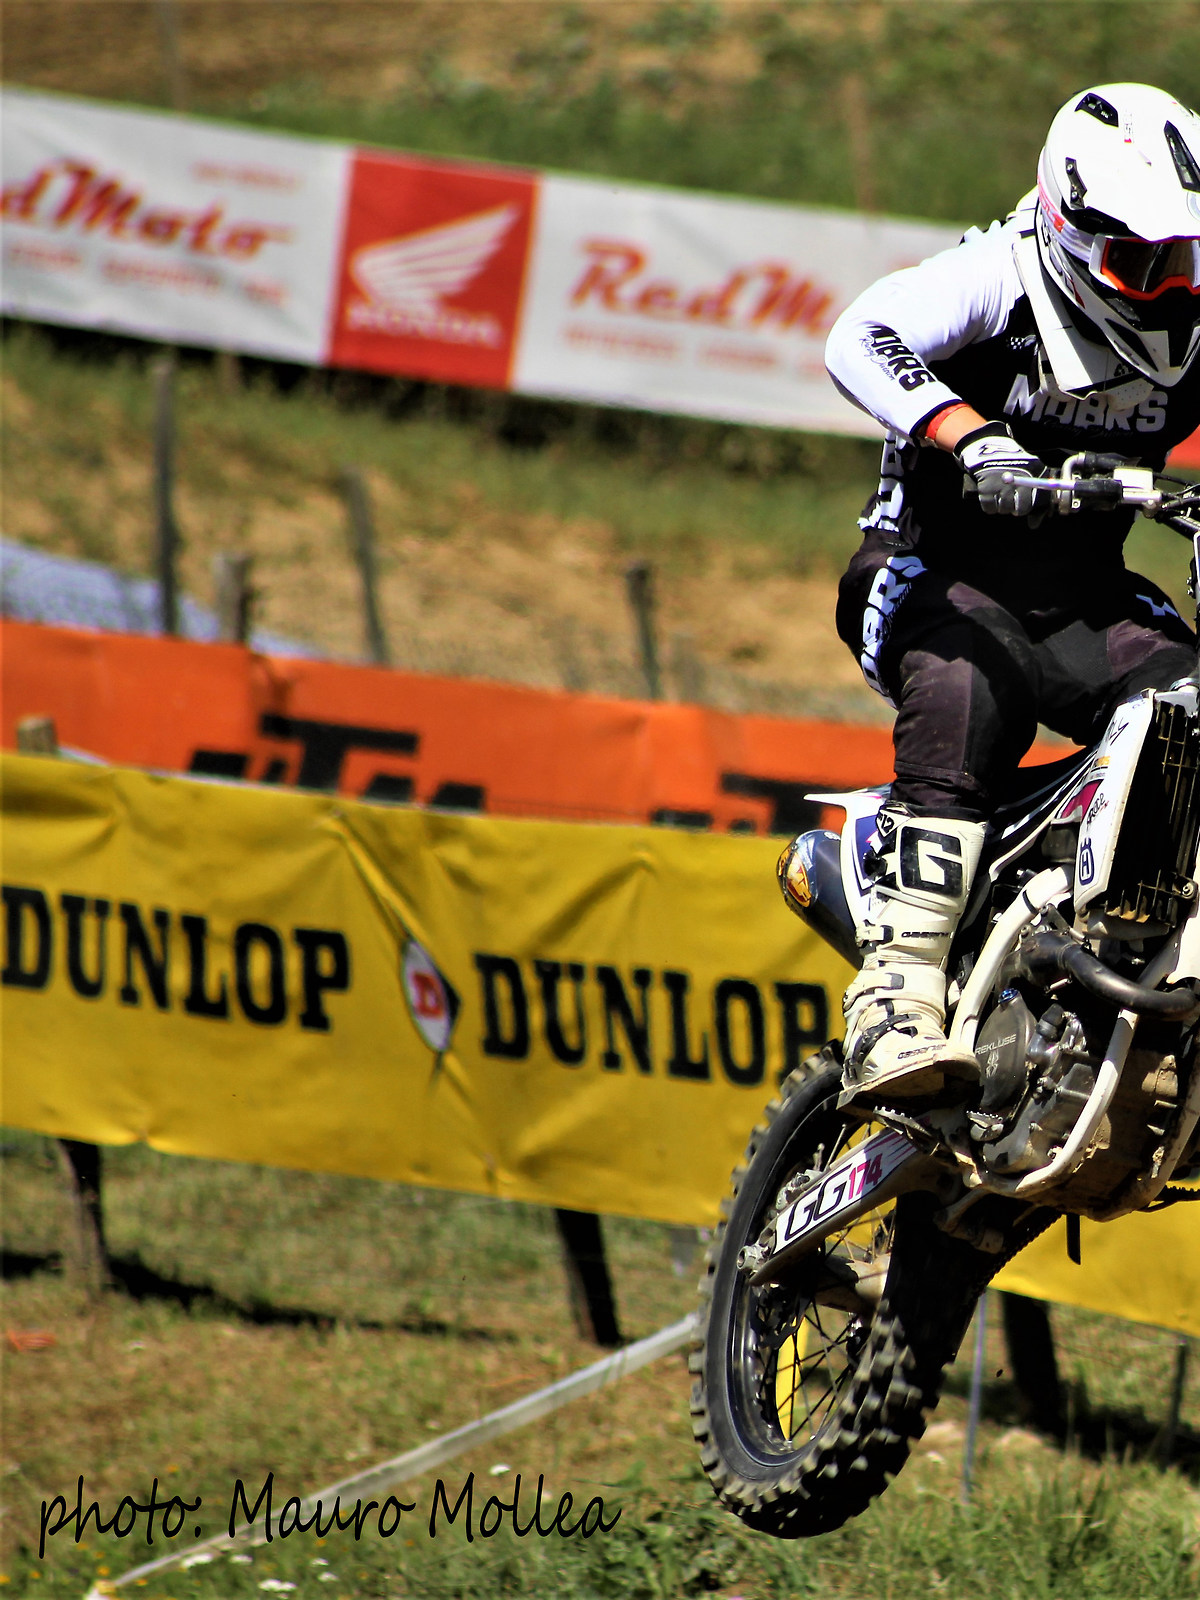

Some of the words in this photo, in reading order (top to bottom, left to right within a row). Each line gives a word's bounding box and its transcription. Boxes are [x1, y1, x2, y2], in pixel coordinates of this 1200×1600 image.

[1, 885, 350, 1032] DUNLOP
[474, 953, 830, 1085] DUNLOP
[974, 1033, 1017, 1056] REKLUSE
